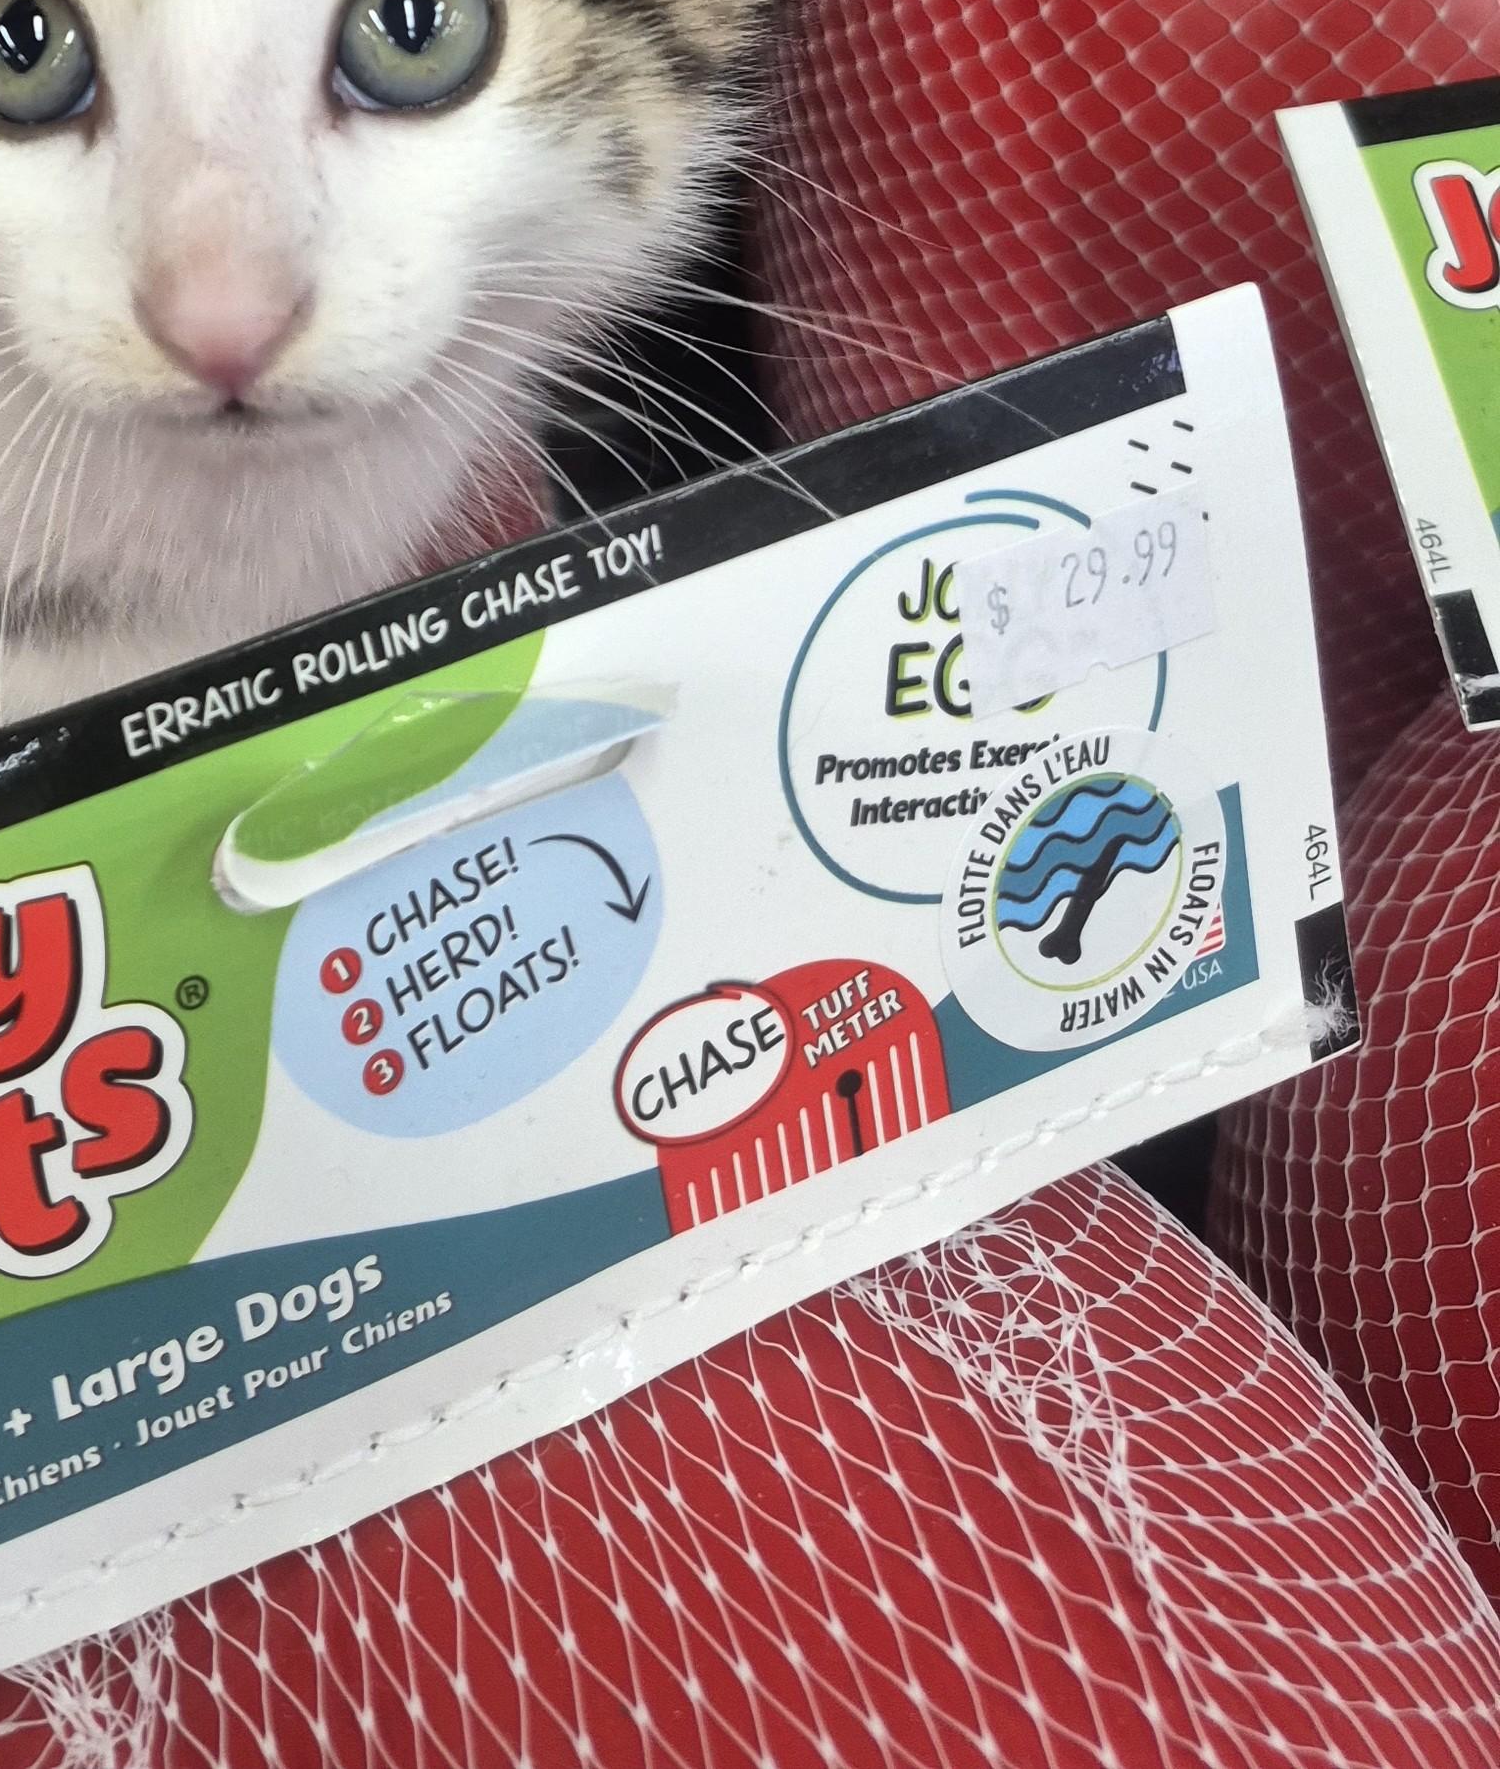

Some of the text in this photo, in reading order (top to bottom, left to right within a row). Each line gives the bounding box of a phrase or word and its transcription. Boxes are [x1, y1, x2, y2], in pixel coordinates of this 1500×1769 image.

[1060, 520, 1177, 610] 29.99
[1415, 515, 1452, 585] 464L
[120, 524, 665, 760] ERRATIC ROLLING CHASE TOY!
[814, 746, 962, 786] Promotes
[956, 734, 1111, 949] FLOTTE DANS L'EAU
[1302, 822, 1336, 901] 464L
[365, 836, 521, 958] CHASE!
[1168, 840, 1220, 947] FLOATS
[386, 904, 521, 1017] HERD!
[405, 925, 581, 1071] FLOATS!
[800, 968, 872, 1032] TUFF
[1059, 975, 1146, 1033] WATER
[1143, 946, 1178, 984] IN
[1181, 958, 1224, 991] USA
[631, 1005, 786, 1122] CHASE
[802, 988, 906, 1070] METER
[50, 1322, 227, 1422] Large
[234, 1253, 384, 1344] Dogs
[134, 1384, 235, 1447] Jouet
[243, 1345, 332, 1399] Pour
[340, 1290, 454, 1356] Chiens
